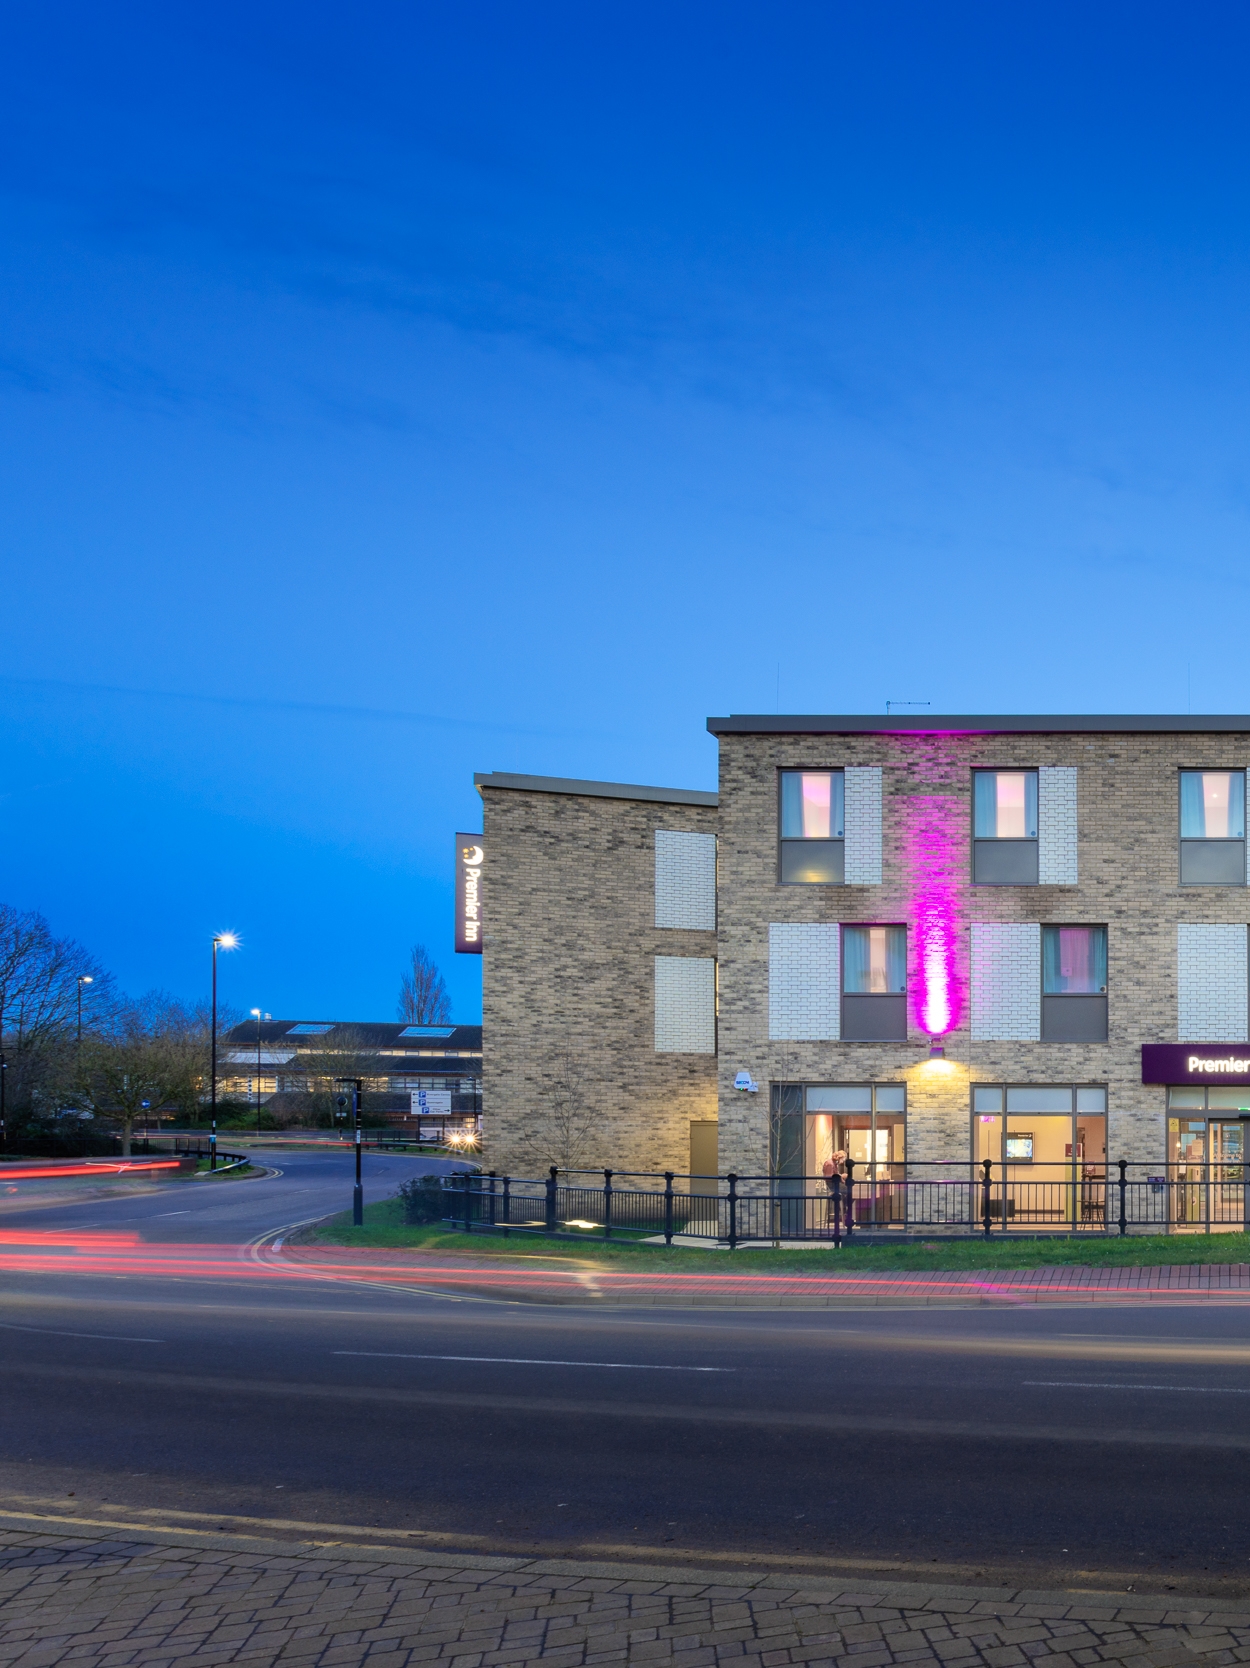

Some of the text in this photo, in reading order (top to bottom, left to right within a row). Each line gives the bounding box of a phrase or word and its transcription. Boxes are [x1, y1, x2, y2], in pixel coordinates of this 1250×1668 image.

[465, 868, 481, 942] Premier Inn
[1188, 1056, 1250, 1073] Premier
